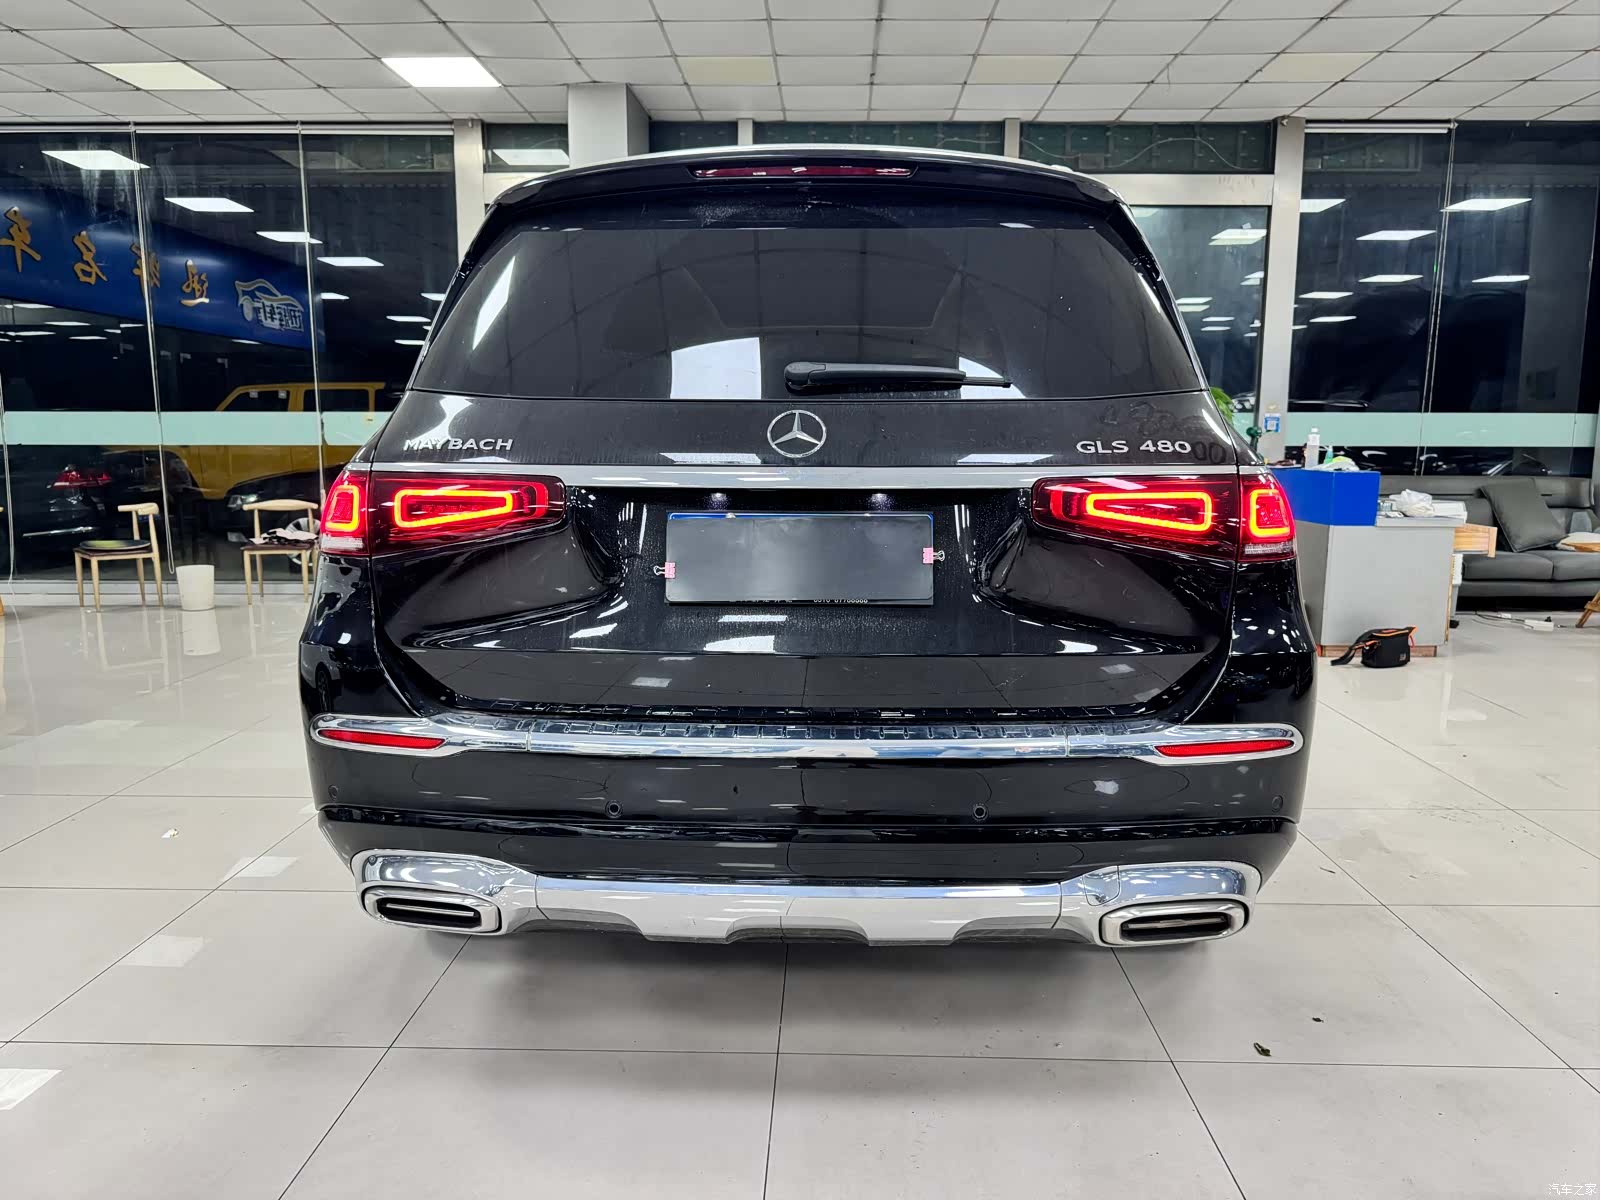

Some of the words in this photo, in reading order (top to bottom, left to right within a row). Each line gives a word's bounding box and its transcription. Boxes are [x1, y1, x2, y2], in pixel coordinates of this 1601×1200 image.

[403, 438, 514, 451] MAYBACH
[1076, 440, 1129, 454] GLS
[1139, 439, 1192, 454] 480
